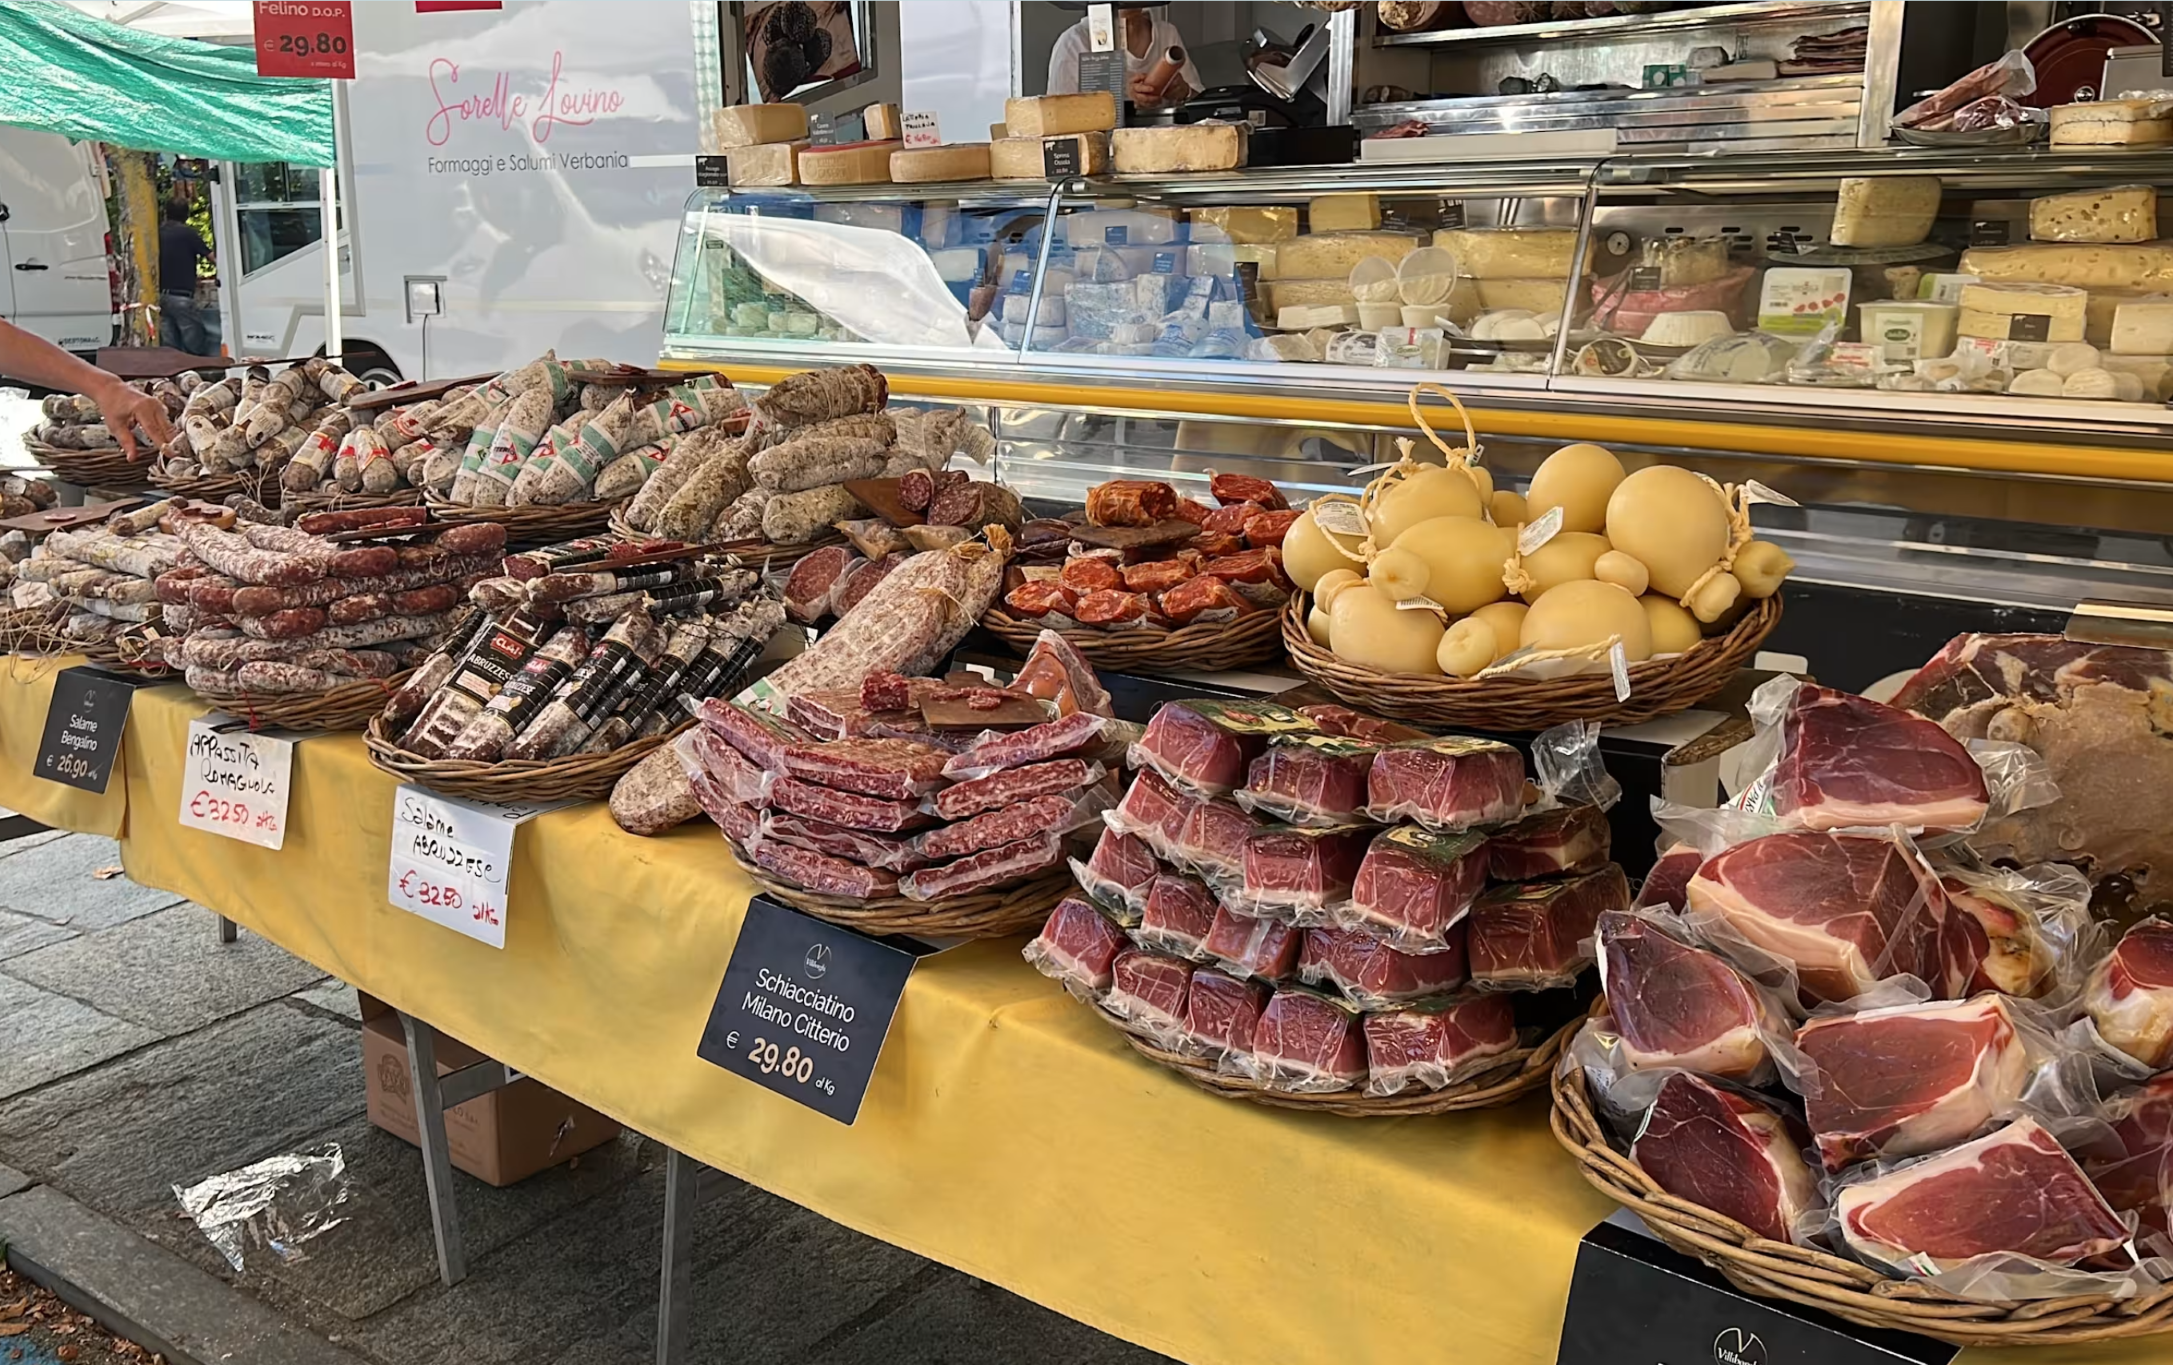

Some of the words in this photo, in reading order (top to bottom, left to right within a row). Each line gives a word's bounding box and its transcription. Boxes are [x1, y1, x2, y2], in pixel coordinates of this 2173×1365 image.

[259, 1, 308, 15] Felino
[312, 7, 345, 17] D.O.P.
[264, 39, 274, 52] €
[279, 32, 347, 57] 29.80
[427, 57, 527, 146] Sorelle
[533, 51, 625, 143] Lovino
[428, 156, 493, 176] Formaggi
[496, 158, 506, 171] e
[509, 154, 556, 172] Salumi
[559, 150, 628, 170] Verbania
[69, 714, 98, 732] Salame
[61, 730, 97, 751] Bengalino
[46, 755, 54, 767] €
[57, 753, 88, 779] 26.90
[401, 797, 454, 838] Salame
[755, 968, 855, 1023] Schiacciatino
[741, 991, 792, 1028] Milano
[794, 1013, 850, 1052] Citterio
[726, 1031, 740, 1049] €
[748, 1037, 813, 1083] 29.80
[824, 1079, 836, 1096] Kg
